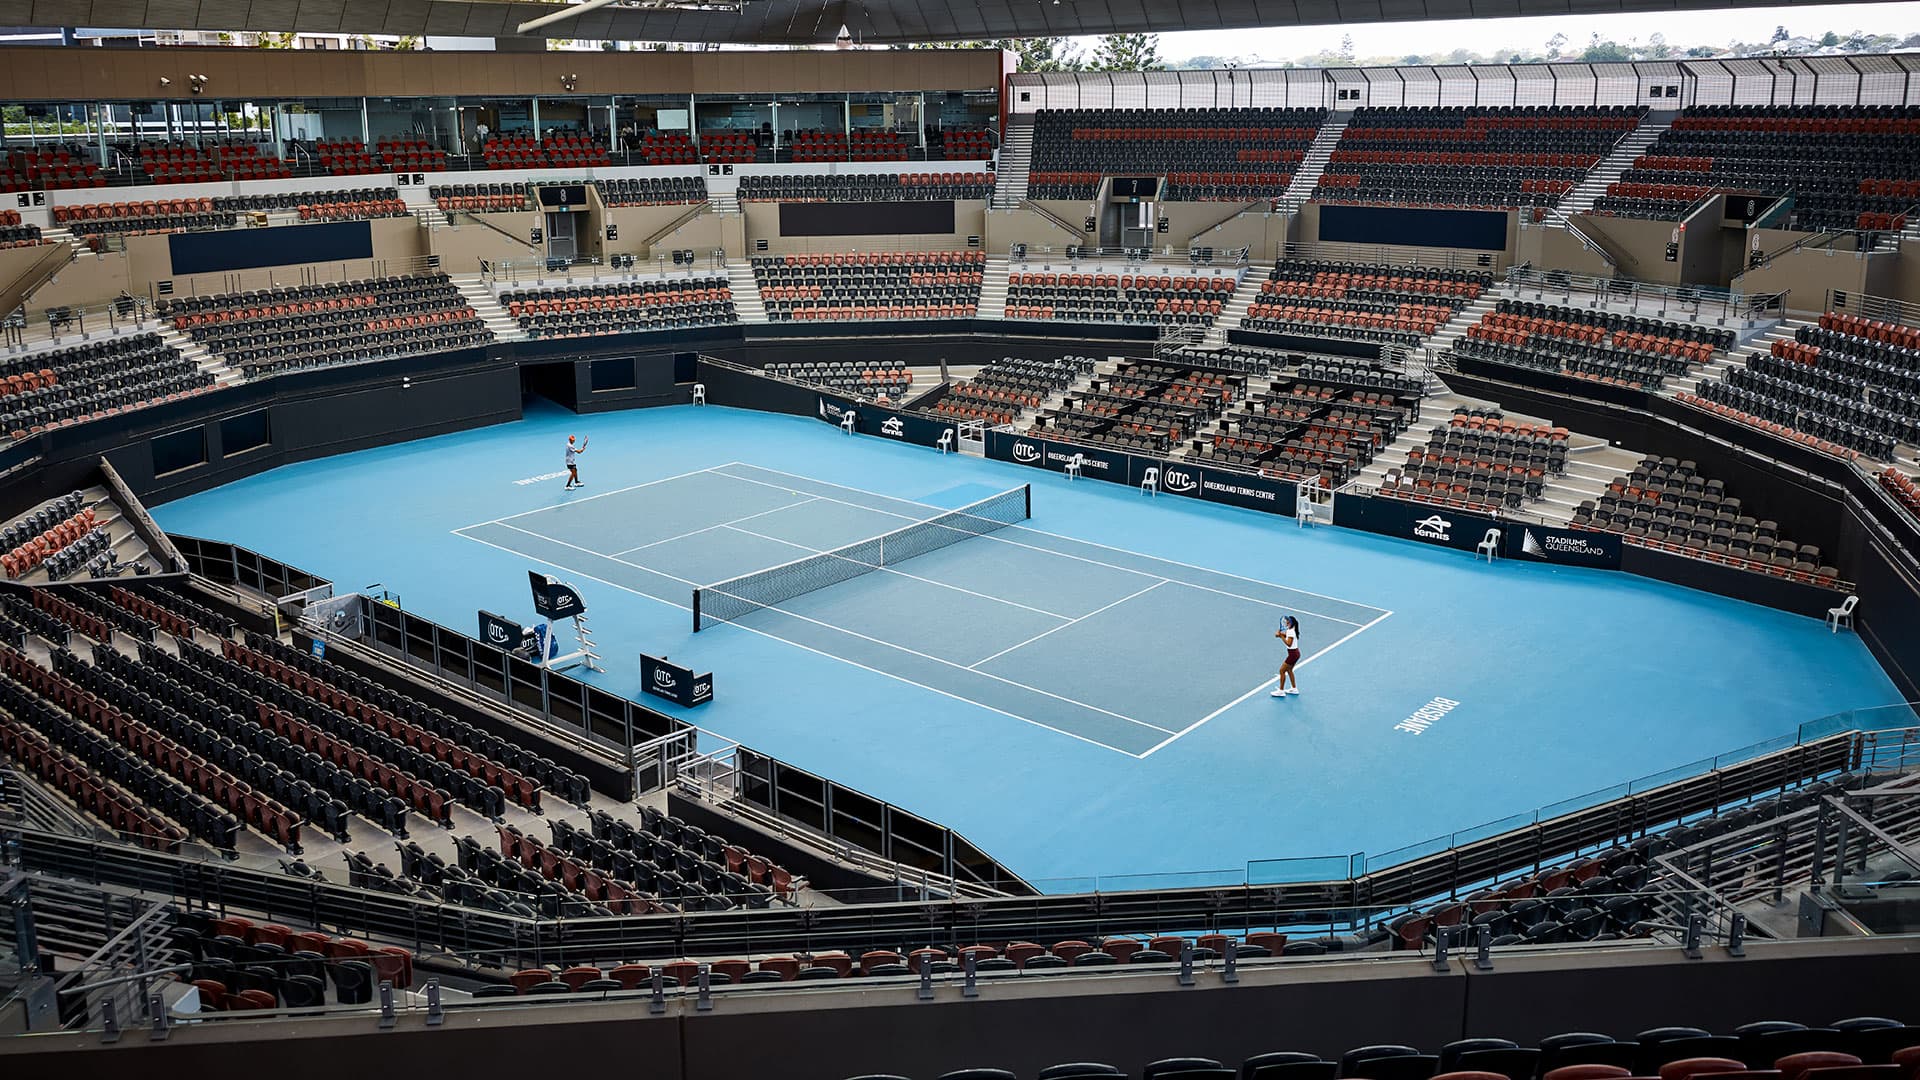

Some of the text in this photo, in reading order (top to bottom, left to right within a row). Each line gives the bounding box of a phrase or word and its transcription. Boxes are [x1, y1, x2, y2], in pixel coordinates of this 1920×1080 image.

[560, 188, 567, 202] 8
[1204, 481, 1237, 493] QUEENSLAND
[1237, 486, 1255, 497] TENNIS
[1255, 490, 1276, 501] CENTRE
[1414, 527, 1450, 541] tennis
[1545, 536, 1587, 547] STADIUMS
[1545, 542, 1604, 556] QUEENSLAND
[1393, 696, 1460, 735] BRISBANE
